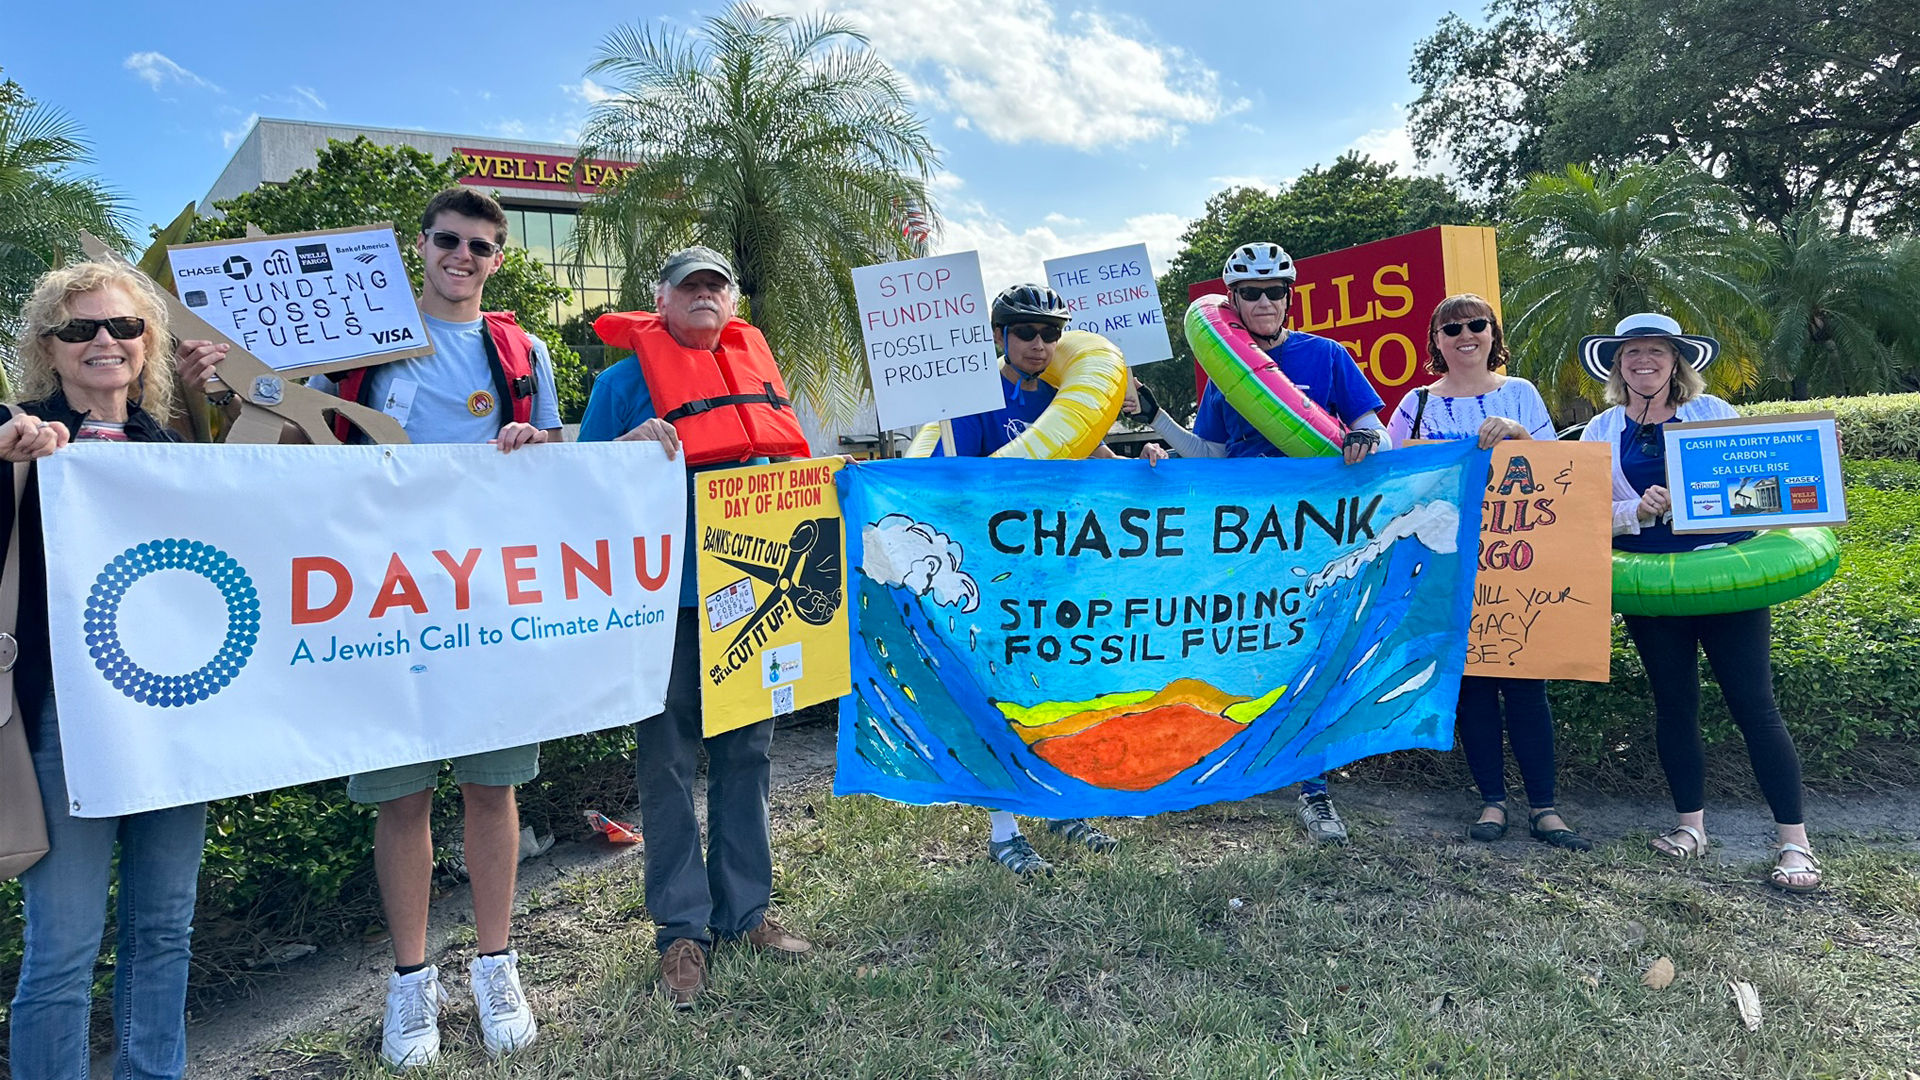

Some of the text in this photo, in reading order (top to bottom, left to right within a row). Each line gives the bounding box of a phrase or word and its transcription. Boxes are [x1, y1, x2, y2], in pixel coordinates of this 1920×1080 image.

[462, 154, 574, 184] WELLS
[178, 266, 221, 278] CHASE
[264, 249, 292, 276] citi
[299, 252, 327, 261] WELLS
[301, 258, 328, 266] FARGO
[220, 270, 388, 306] FUNDING
[879, 268, 950, 298] STOP
[1053, 261, 1141, 288] THE SEAS
[232, 293, 384, 329] FOSSIL
[867, 294, 975, 330] FUNDING
[1066, 296, 1090, 312] RE
[1284, 262, 1414, 333] LLS
[244, 317, 362, 350] FUELS
[368, 328, 414, 344] VISA
[1105, 314, 1133, 332] ARE
[871, 324, 992, 360] FOSSIL FUEL
[884, 352, 988, 386] PROJECTS!
[1686, 439, 1713, 450] CASH
[1716, 440, 1726, 448] IN
[1729, 438, 1737, 447] A
[1740, 436, 1771, 446] DIRTY
[1773, 434, 1803, 444] BANK
[1723, 450, 1767, 461] CARBON
[708, 466, 830, 500] STOP DIRTY BANKS
[1554, 460, 1574, 495] &
[1712, 462, 1790, 475] SEA LEVEL RISE
[724, 487, 821, 519] DAY OF ACTION
[988, 494, 1383, 559] CHASE BANK
[732, 533, 754, 559] CUT
[752, 537, 766, 562] IT
[764, 541, 788, 566] OUT
[1478, 539, 1534, 571] RGO
[291, 534, 672, 626] DAYENU
[715, 590, 749, 610] FUNDING
[717, 598, 747, 616] FOSSIL
[720, 604, 744, 620] FUELS
[1000, 587, 1300, 631] STOP FUNDING
[1516, 586, 1592, 613] YOUR
[290, 605, 664, 666] A Jewish Call to Climate Action
[728, 636, 754, 670] CUT
[752, 622, 768, 648] IT
[768, 600, 792, 632] UP!
[1005, 618, 1306, 666] FOSSIL FUELS
[1470, 610, 1541, 644] GACY
[710, 664, 721, 678] OR
